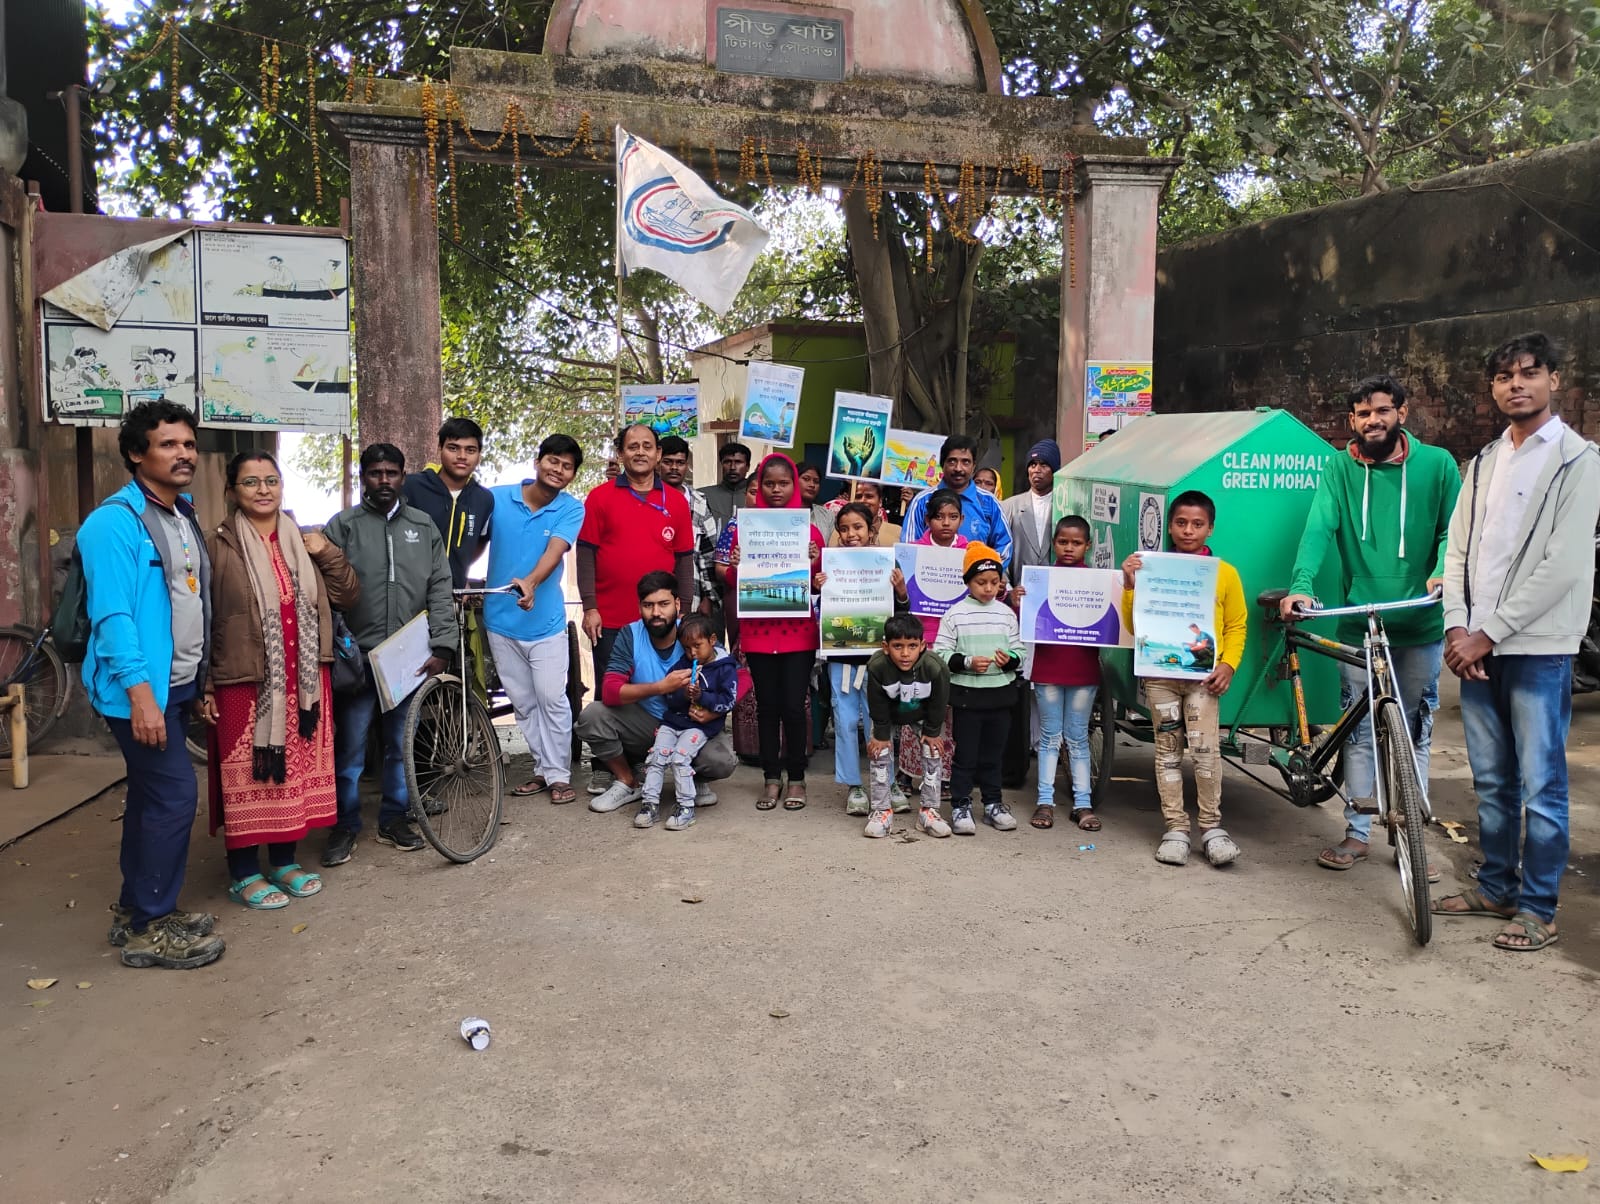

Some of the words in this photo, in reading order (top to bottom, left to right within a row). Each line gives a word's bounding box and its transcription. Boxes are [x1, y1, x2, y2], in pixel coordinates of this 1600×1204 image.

[787, 22, 835, 41] ঘাট
[1222, 452, 1271, 470] CLEAN
[1222, 472, 1270, 489] GREEN
